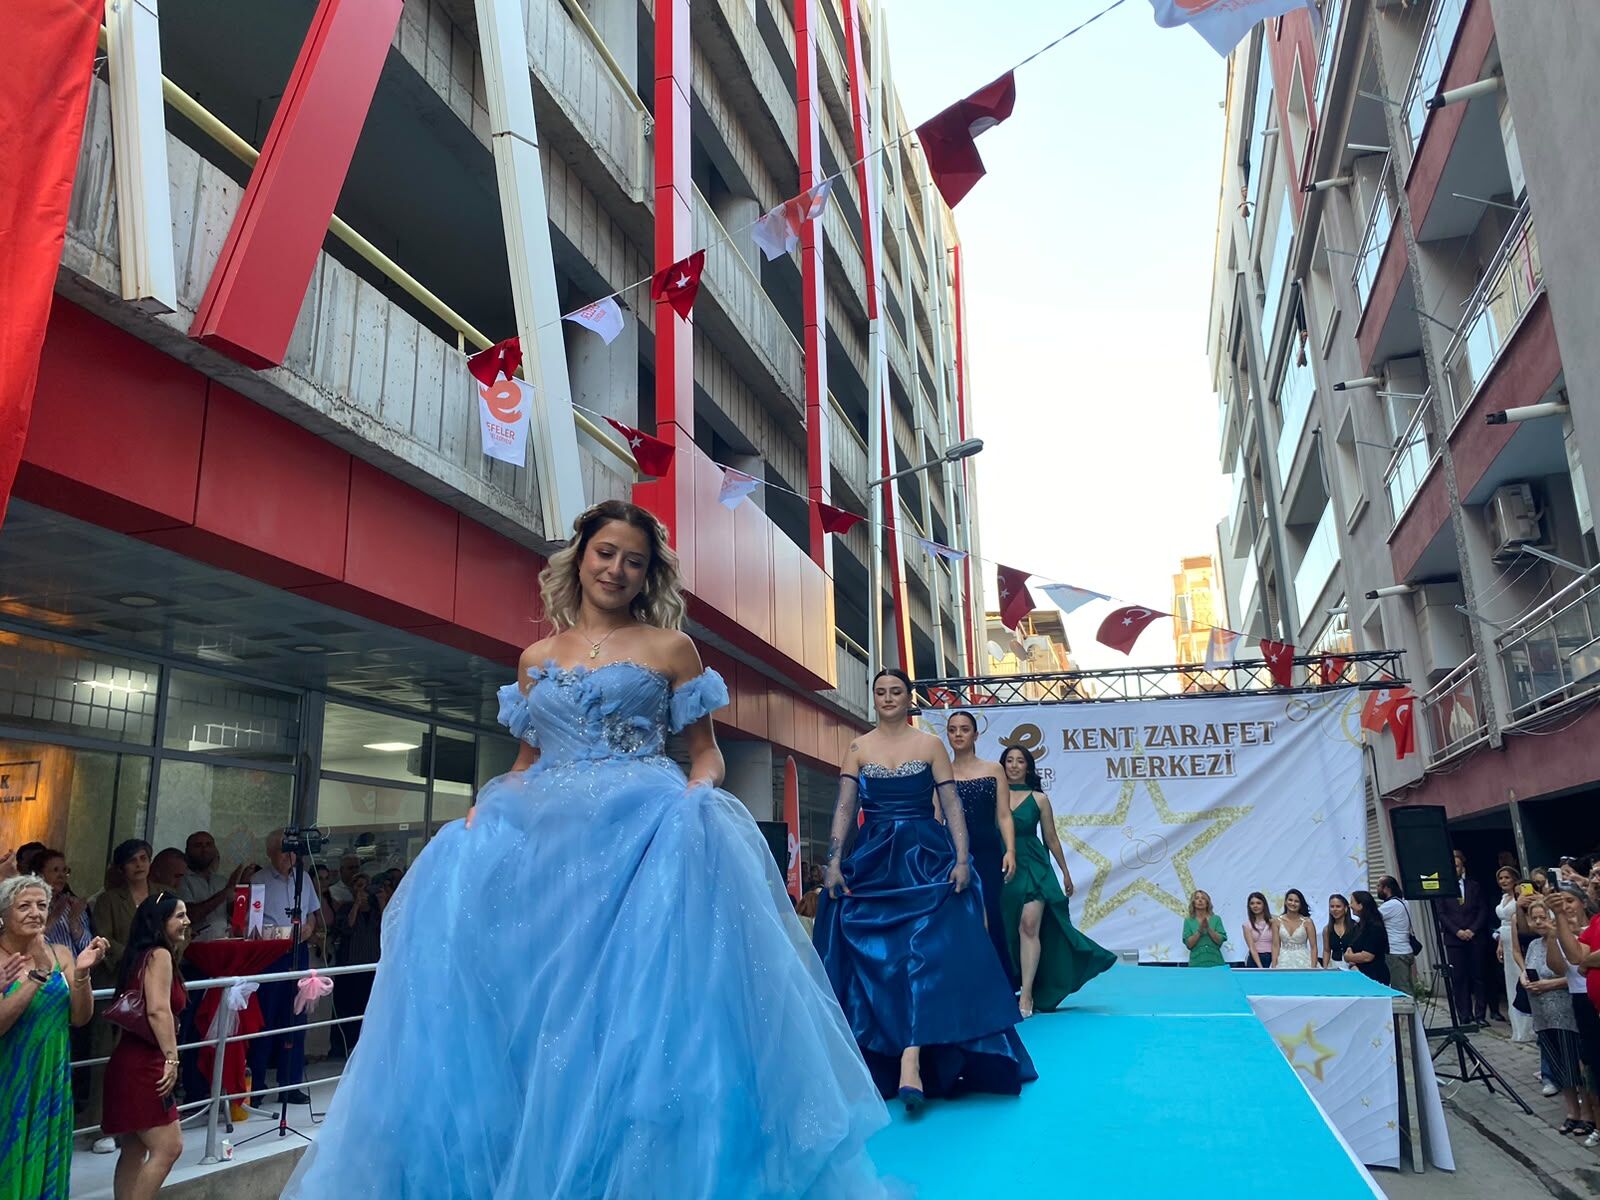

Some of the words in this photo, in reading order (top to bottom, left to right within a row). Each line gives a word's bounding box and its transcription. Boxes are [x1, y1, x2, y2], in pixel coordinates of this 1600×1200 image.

[1062, 726, 1135, 750] KENT
[1143, 720, 1275, 748] ZARAFET
[1106, 749, 1234, 779] MERKEZİ
